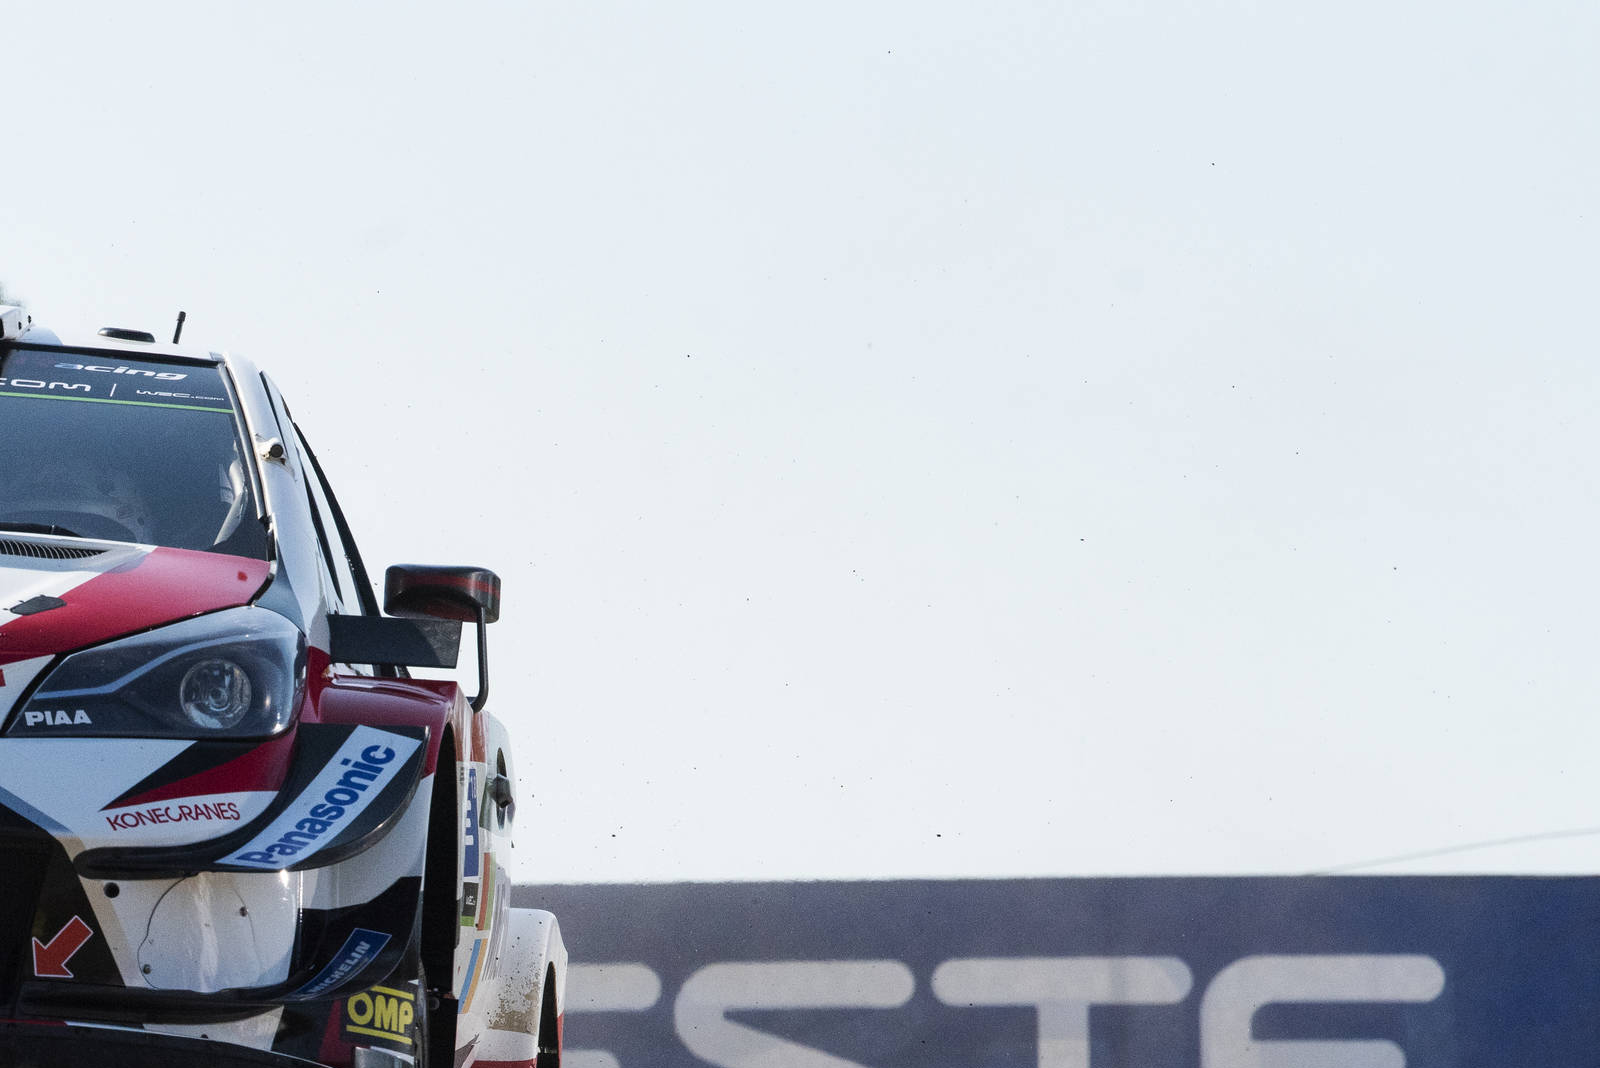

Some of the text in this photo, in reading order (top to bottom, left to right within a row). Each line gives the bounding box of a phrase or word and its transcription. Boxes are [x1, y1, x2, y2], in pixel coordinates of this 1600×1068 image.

[54, 362, 188, 381] acing
[24, 709, 92, 727] PIAA
[106, 802, 240, 831] KONECRANES
[236, 744, 396, 864] Panasonic
[347, 992, 414, 1034] OMP
